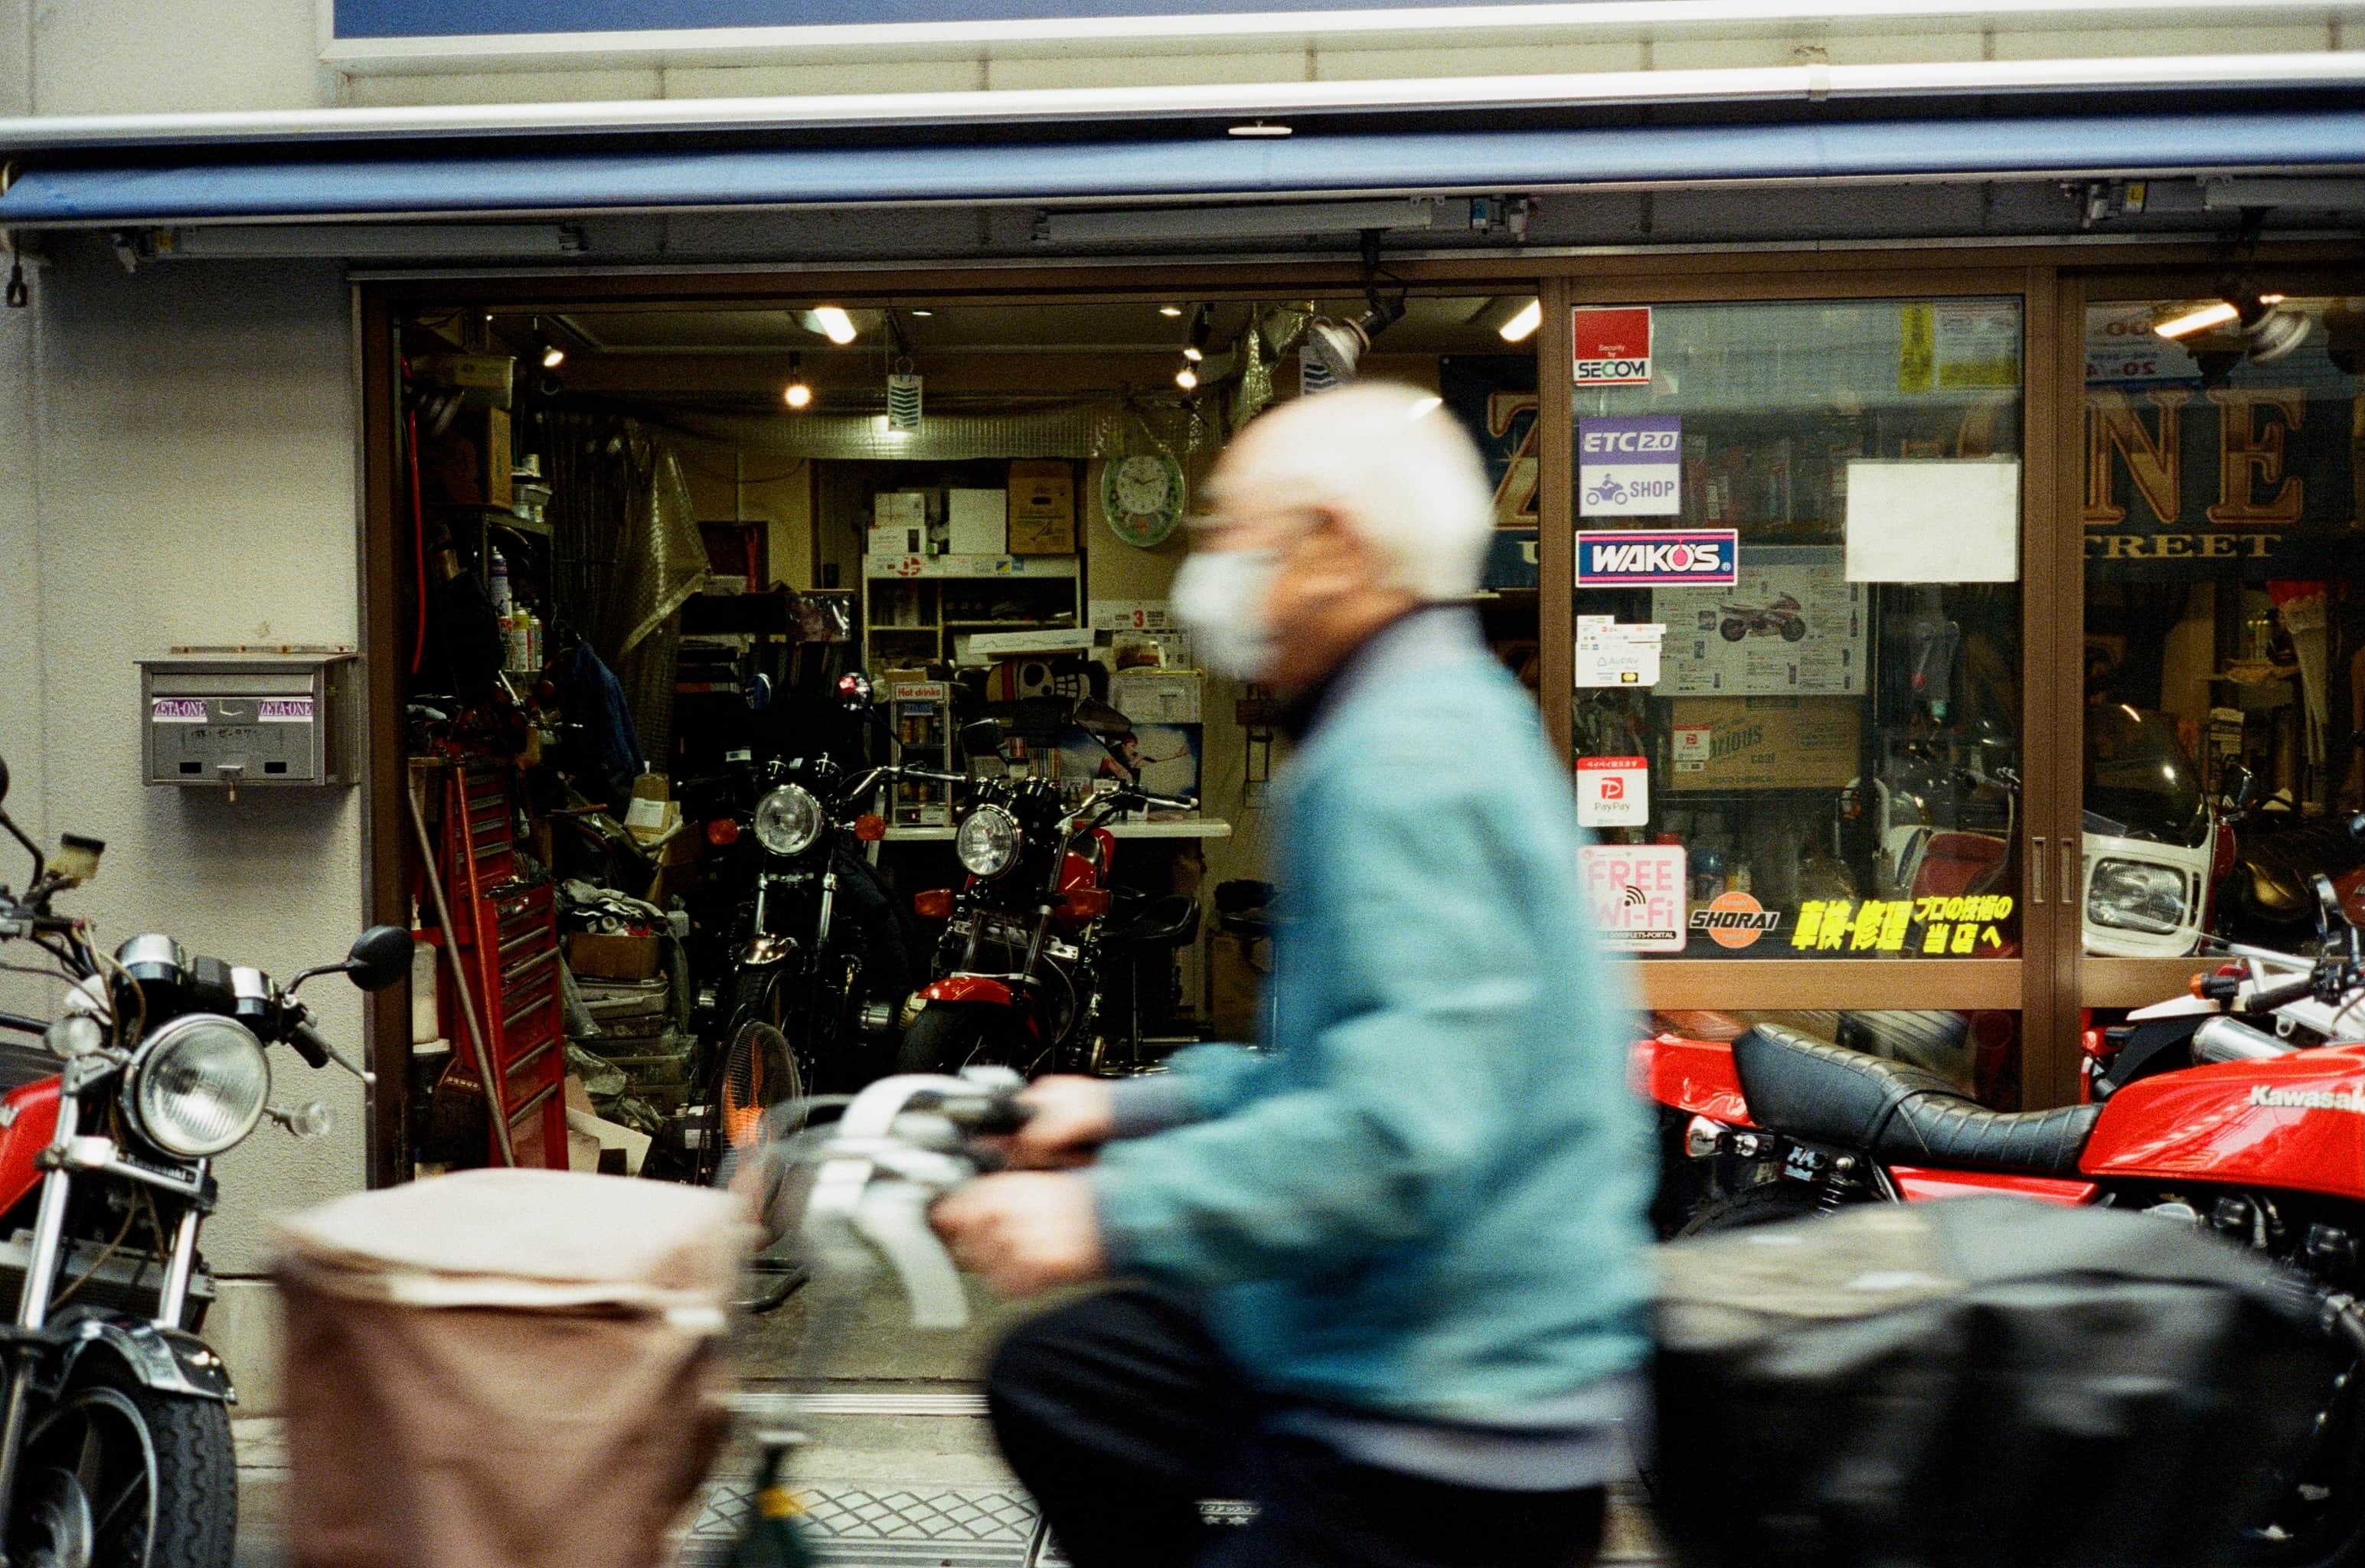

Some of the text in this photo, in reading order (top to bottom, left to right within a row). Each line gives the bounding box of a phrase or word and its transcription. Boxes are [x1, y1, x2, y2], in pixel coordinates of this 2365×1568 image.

[1578, 361, 1645, 377] SECOM
[1630, 481, 1674, 498] SHOP
[1592, 544, 1720, 572] WAKO'S
[2084, 534, 2282, 558] REET
[1133, 609, 1144, 628] 3
[898, 687, 941, 697] Hot drinks
[1595, 802, 1631, 812] PayPay
[1587, 860, 1673, 891] FREE
[1592, 897, 1674, 928] Wi-Fi
[1690, 911, 1777, 929] SHORAI
[1915, 894, 2014, 923] プロの技術の
[1923, 923, 2002, 954] 当店へ
[2249, 1080, 2365, 1113] Kawasak
